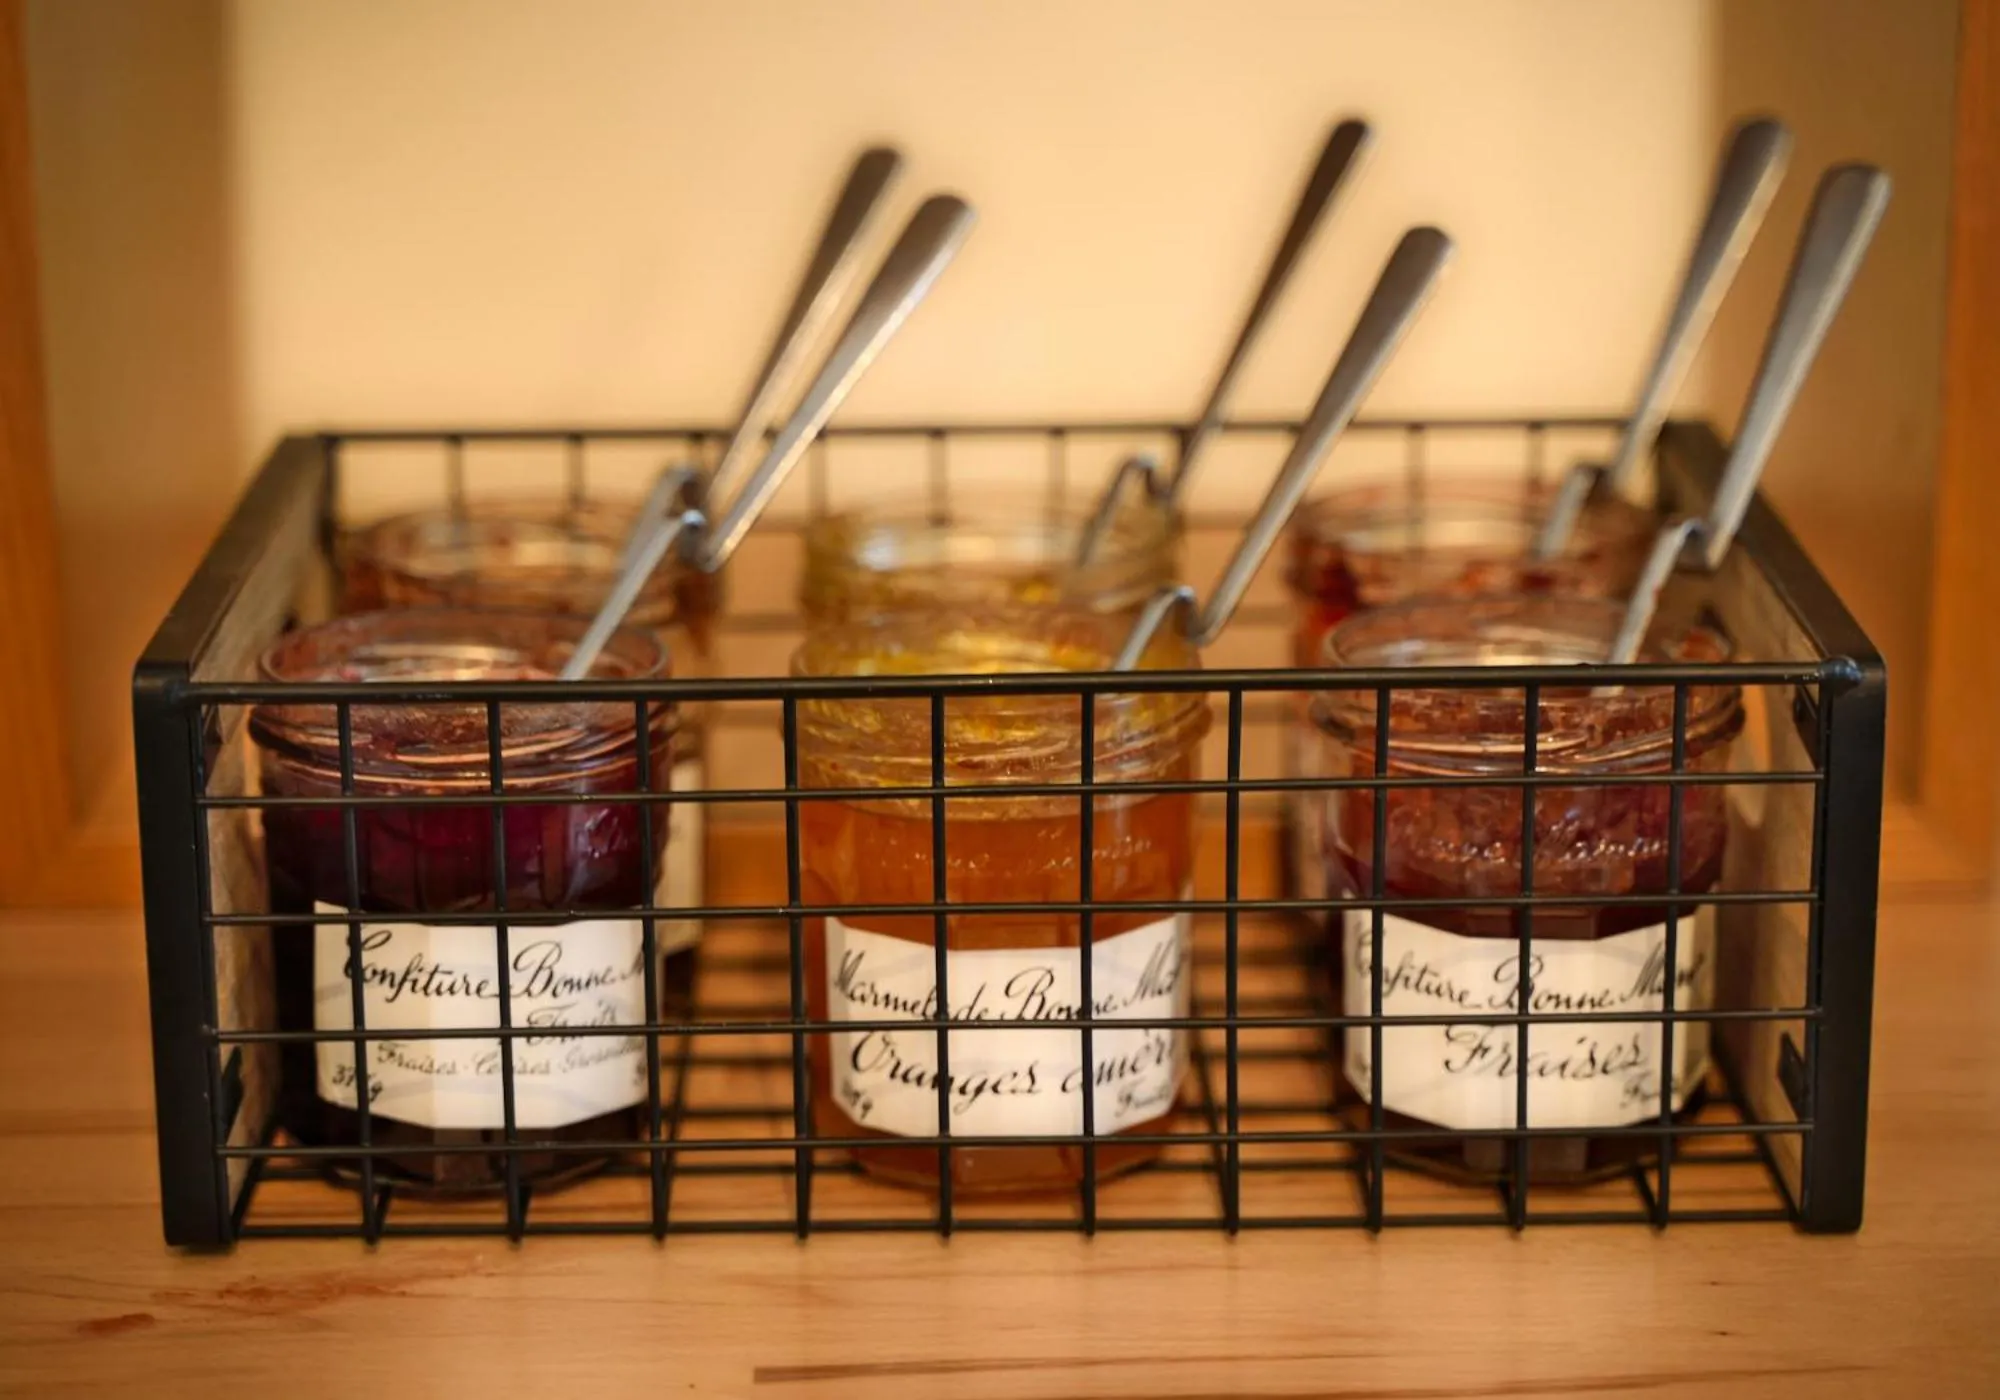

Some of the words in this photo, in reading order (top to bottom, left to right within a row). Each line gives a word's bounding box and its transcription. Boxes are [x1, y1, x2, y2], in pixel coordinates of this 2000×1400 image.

[343, 926, 499, 1003] Confiture
[509, 939, 617, 1000] Bonne
[835, 948, 989, 1021] Marmelde
[1354, 926, 1483, 1010] Cfiture
[1486, 952, 1615, 1011] Bonne
[377, 1042, 457, 1076] Fraises
[1443, 1023, 1649, 1080] Fraises
